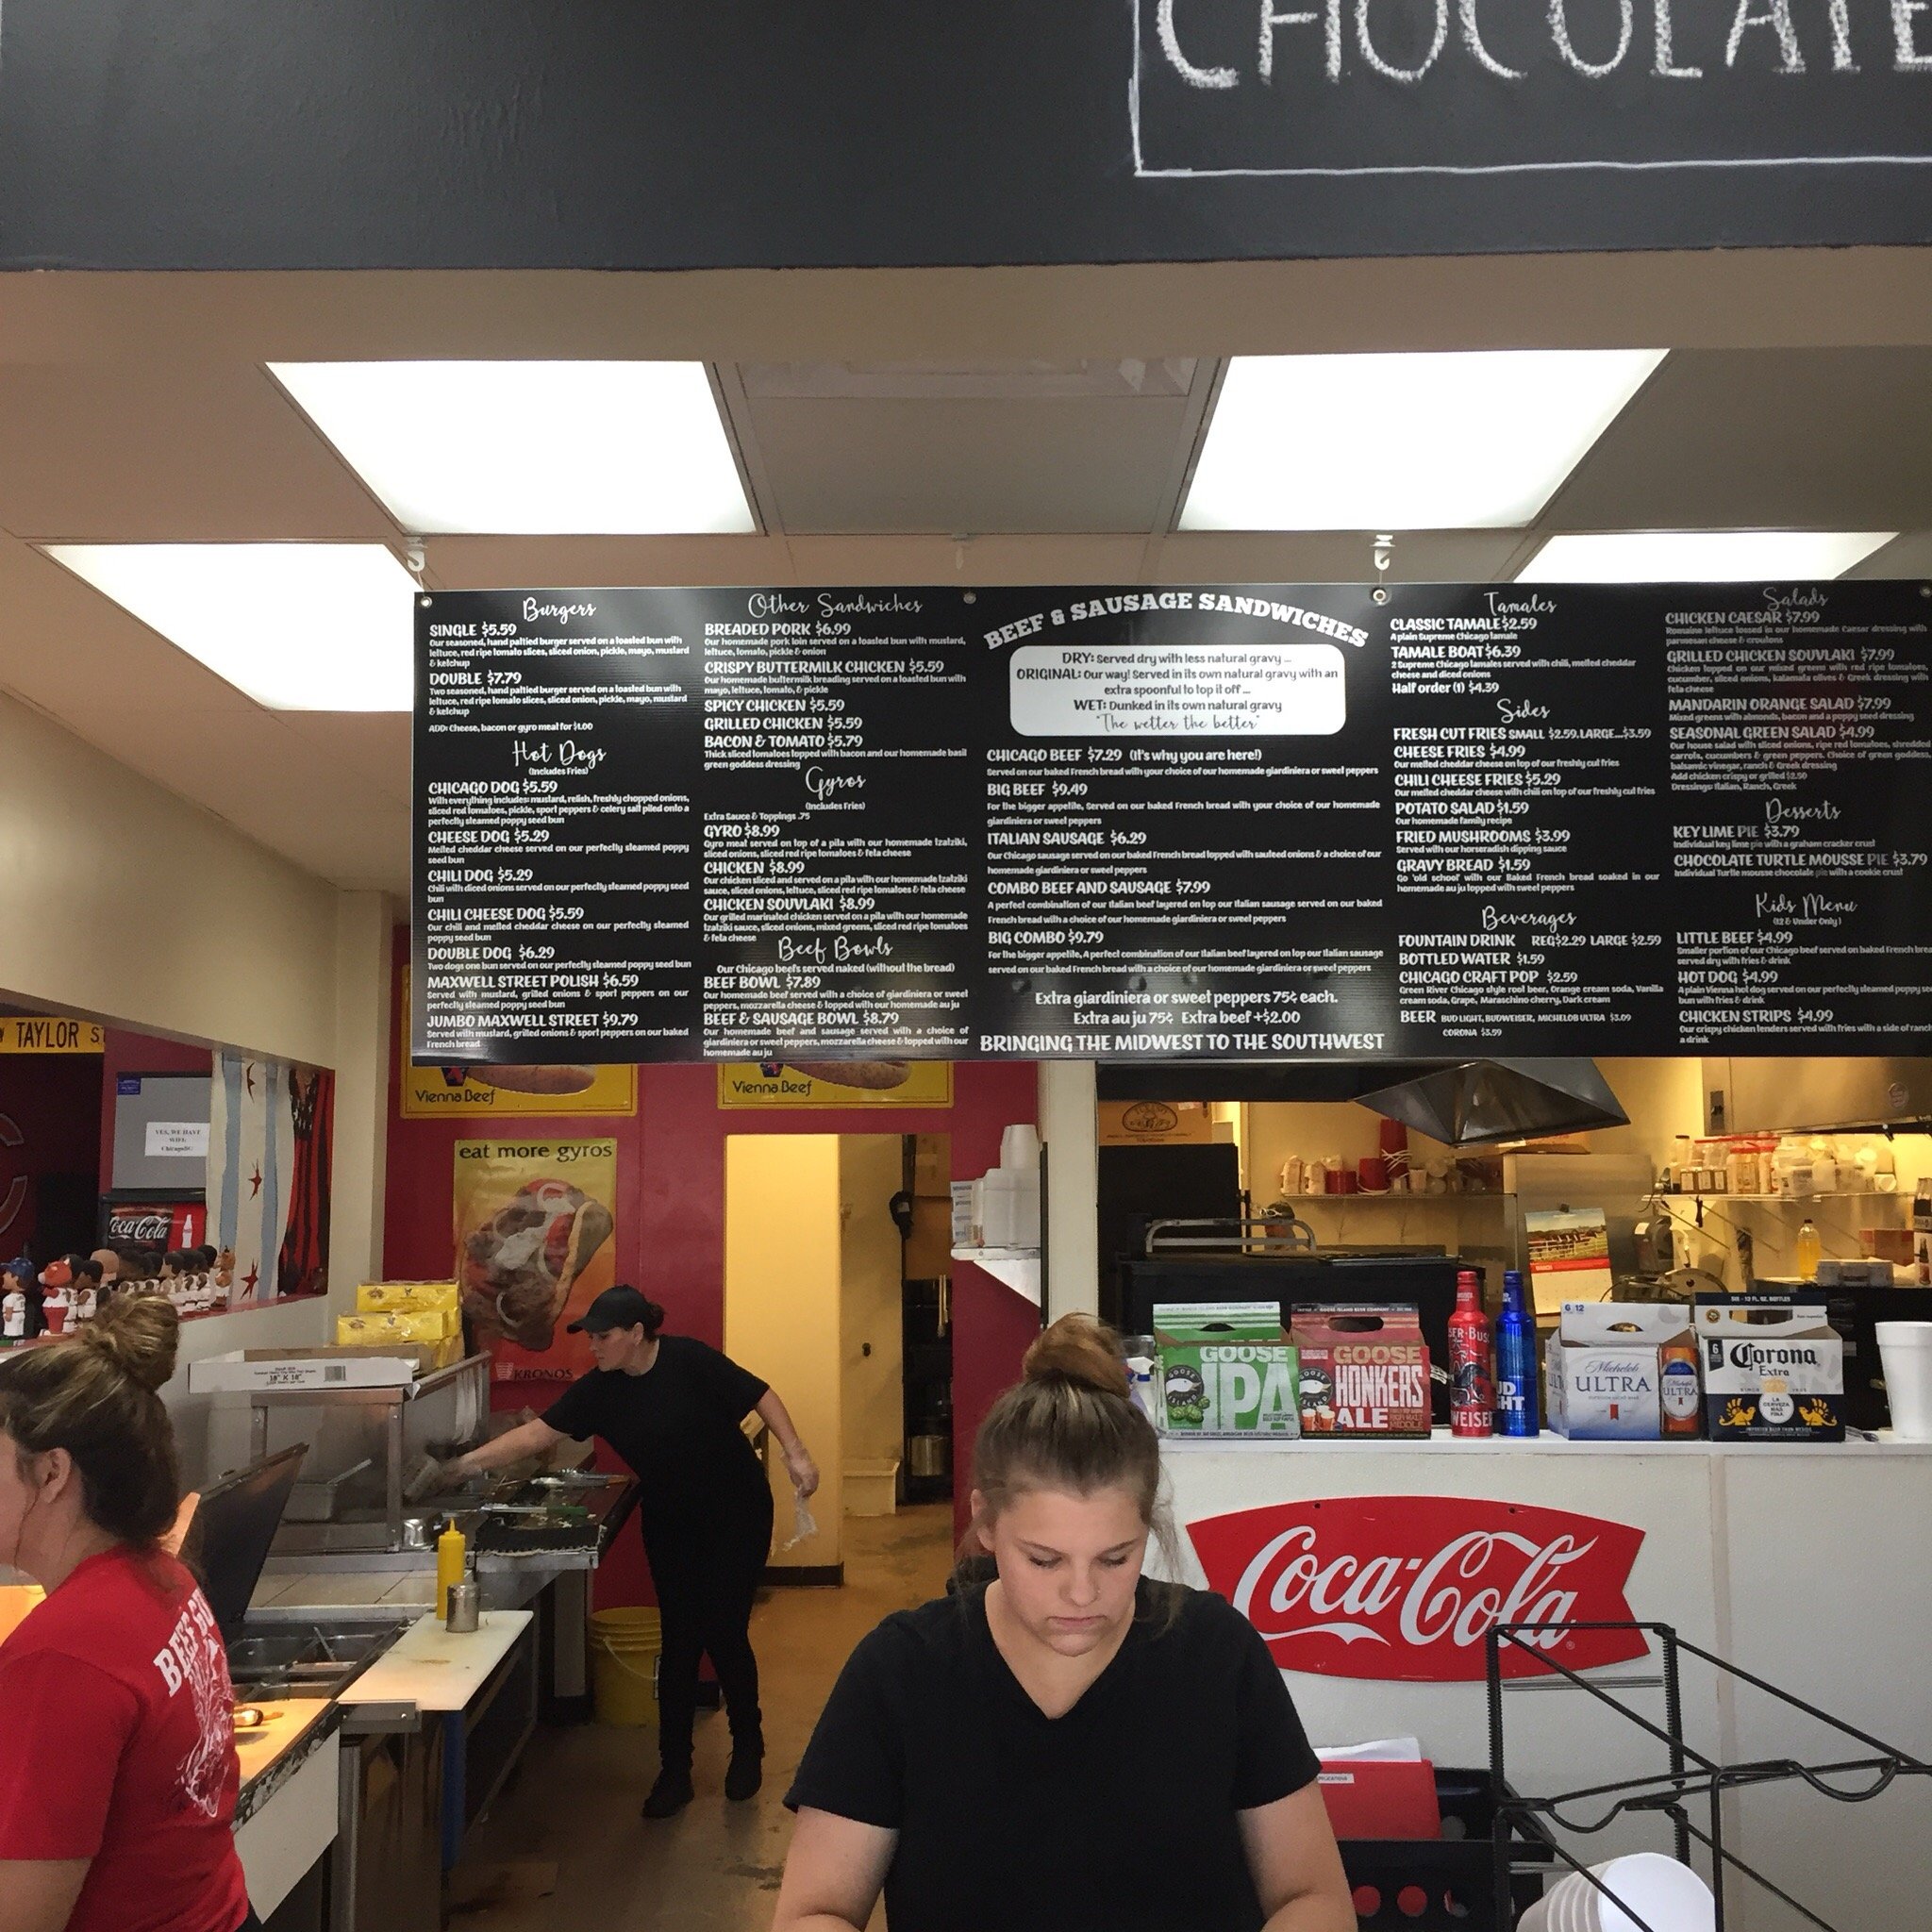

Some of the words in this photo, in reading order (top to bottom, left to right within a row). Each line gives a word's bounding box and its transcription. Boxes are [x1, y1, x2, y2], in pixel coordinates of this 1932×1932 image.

[748, 592, 809, 618] Other
[817, 592, 923, 618] Sandwiches
[1484, 591, 1557, 616] Tamales
[1763, 587, 1828, 611] Salads
[523, 597, 596, 625] Burgers
[429, 625, 477, 637] SINGLE
[482, 622, 517, 637] $5.59
[983, 613, 1044, 650] BEEF
[1052, 608, 1066, 625] &
[1070, 592, 1193, 622] SAUSAGE
[1199, 593, 1369, 648] SANDWICHES
[1062, 653, 1094, 664] DRY:
[1137, 654, 1157, 666] dry
[1158, 653, 1182, 663] with
[1185, 654, 1206, 663] less
[1208, 653, 1247, 663] natural
[1250, 655, 1281, 665] gravy
[1391, 646, 1445, 658] TAMALE
[1448, 646, 1484, 658] BOAT
[1485, 643, 1522, 659] $6.39
[705, 661, 755, 674] CRISPY
[757, 661, 842, 673] BUTTERMILK
[845, 660, 905, 673] CHICKEN
[908, 658, 944, 674] $5.59
[1392, 683, 1417, 693] Half
[1418, 684, 1451, 693] order
[1469, 681, 1499, 694] $4.39
[1496, 698, 1550, 724] Sides
[1669, 699, 1747, 710] MANDARIN
[1750, 698, 1807, 710] ORANGE
[1810, 698, 1855, 709] SALAD
[1857, 696, 1891, 710] $7.99
[1134, 715, 1177, 731] wetter
[1184, 714, 1208, 730] the
[512, 741, 552, 767] Hot
[559, 741, 607, 769] Dogs
[987, 750, 1047, 762] CHICAGO
[1050, 749, 1082, 762] BEEF
[1088, 746, 1123, 762] $7.29
[428, 782, 489, 794] CHICAGO
[491, 782, 520, 794] DOG
[523, 779, 558, 794] $5.59
[806, 766, 866, 801] Gyros
[1765, 798, 1840, 824] Desserts
[1396, 831, 1436, 843] FRIED
[1439, 831, 1531, 843] MUSHROOMS
[1535, 828, 1571, 844] $3.99
[1674, 826, 1700, 838] KEY
[1702, 825, 1735, 838] LIME
[1738, 825, 1758, 837] PIE
[1764, 824, 1800, 838] $3.79
[1755, 892, 1797, 918] Kids
[1803, 892, 1857, 915] Menu
[1481, 905, 1577, 933] Beverages
[1676, 933, 1719, 944] LITTLE
[1722, 932, 1754, 943] BEEF
[1757, 929, 1792, 944] $4.99
[778, 936, 826, 964] Beef
[834, 936, 892, 960] Bowls
[736, 965, 774, 975] Chicago
[803, 965, 834, 974] served
[836, 964, 864, 974] naked
[427, 976, 495, 989] MAXWELL
[498, 975, 548, 988] STREET
[550, 975, 599, 987] POLISH
[603, 973, 639, 988] $6.59
[1035, 992, 1071, 1005] Extra
[1074, 992, 1151, 1007] giardiniera
[1153, 994, 1168, 1005] or
[1171, 991, 1211, 1005] sweet
[1214, 991, 1271, 1007] peppers
[1401, 1010, 1436, 1023] BEER
[1441, 1014, 1457, 1023] BUD
[16, 1022, 78, 1048] TAYLOR
[980, 1036, 1073, 1052] BRINGING
[1075, 1035, 1111, 1051] THE
[1113, 1034, 1204, 1051] MIDWEST
[1207, 1034, 1229, 1050] TO
[1233, 1034, 1269, 1050] THE
[1272, 1034, 1385, 1050] SOUTHWEST
[732, 1080, 778, 1095] Vienna
[781, 1079, 812, 1097] Beef
[415, 1090, 462, 1103] Vienna
[464, 1090, 495, 1104] Beef
[459, 1145, 491, 1158] eat
[498, 1145, 550, 1158] more
[557, 1144, 612, 1162] gyros
[1200, 1346, 1288, 1363] GOOSE
[1333, 1346, 1423, 1364] GOOSE
[1730, 1342, 1818, 1371] Corona
[514, 1369, 574, 1378] KRONOS
[1168, 1369, 1196, 1378] GOOSE
[1759, 1366, 1790, 1376] Extra
[1335, 1365, 1424, 1407] HONKERS
[1576, 1376, 1652, 1391] ULTRA
[1663, 1387, 1698, 1395] ULTRA
[1201, 1363, 1300, 1430] IPA
[1338, 1407, 1388, 1428] ALE
[1232, 1525, 1600, 1650] Coca-Cola
[153, 1610, 200, 1698] BEEF
